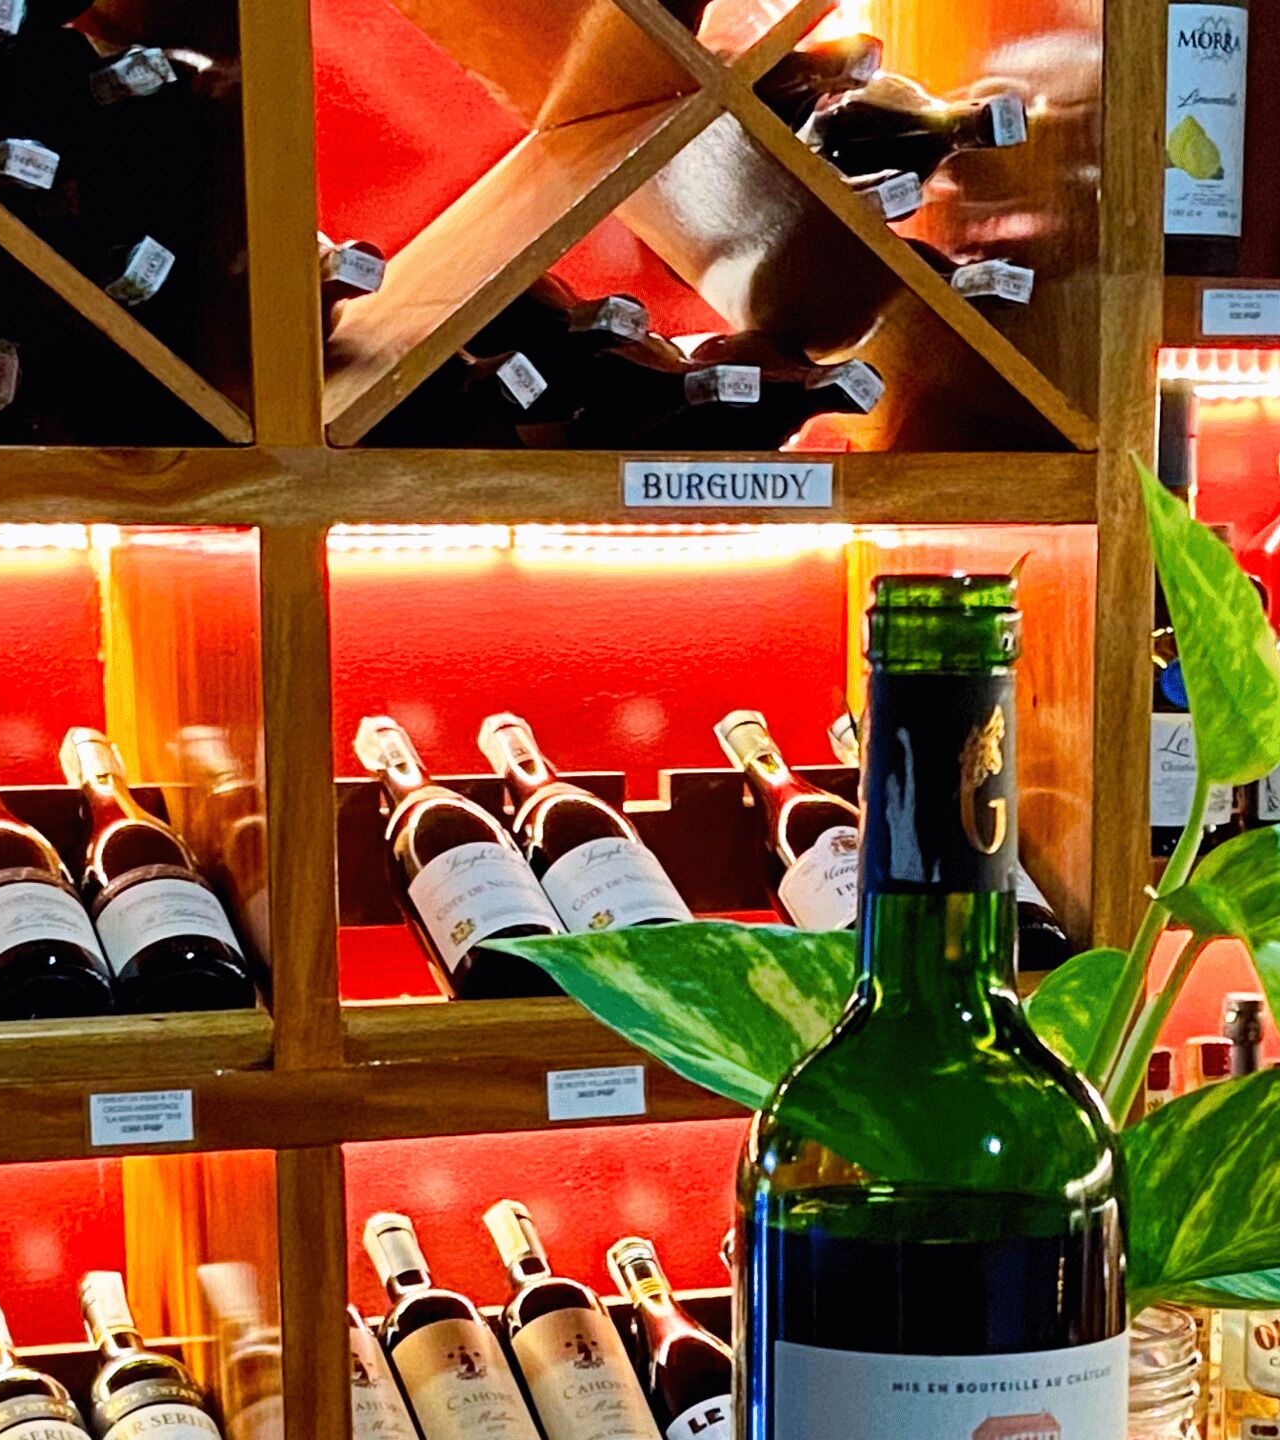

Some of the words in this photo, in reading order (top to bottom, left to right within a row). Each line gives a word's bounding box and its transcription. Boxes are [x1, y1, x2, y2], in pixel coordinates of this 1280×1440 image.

[1178, 28, 1241, 53] MORRA
[643, 469, 813, 501] BURGUNDY
[892, 1381, 920, 1393] MIS
[928, 1381, 949, 1393] EN
[956, 1378, 1039, 1393] BOUTEILLE
[688, 1407, 724, 1436] LE
